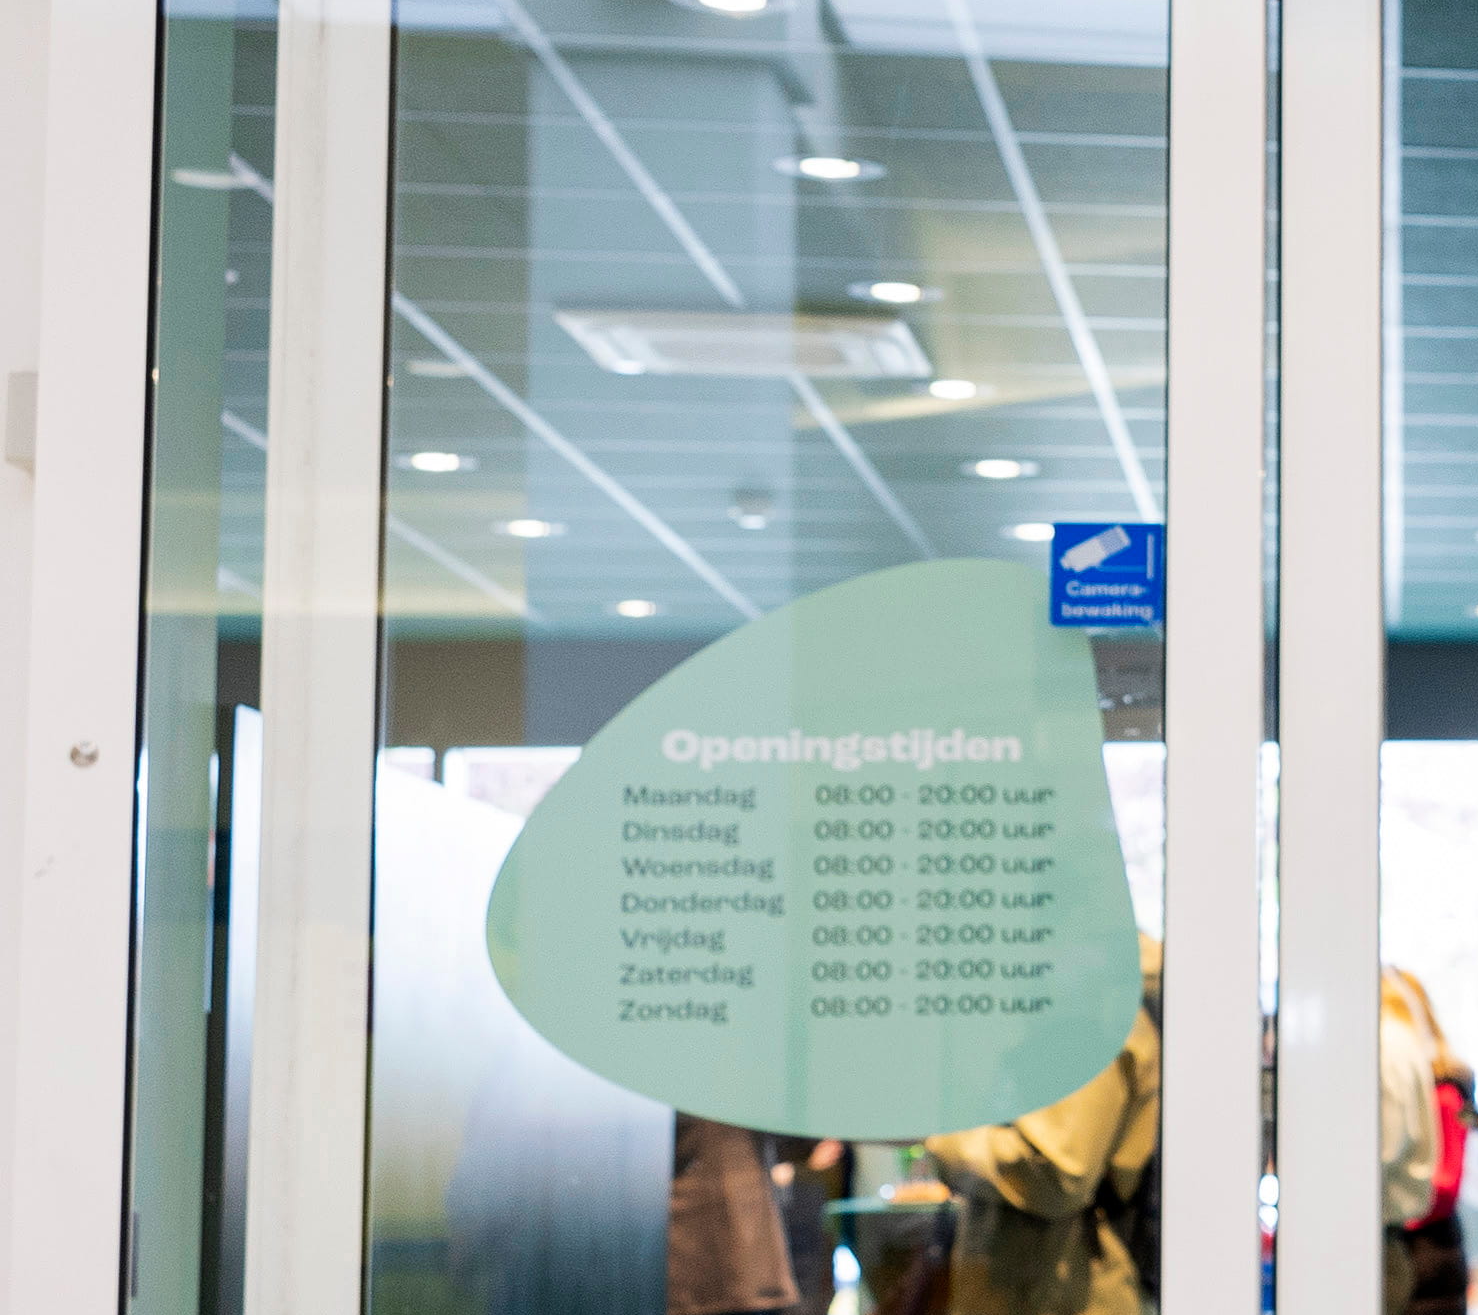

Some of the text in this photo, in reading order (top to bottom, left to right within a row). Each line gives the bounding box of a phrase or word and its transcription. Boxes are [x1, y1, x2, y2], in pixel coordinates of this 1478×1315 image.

[662, 729, 1021, 771] Openingstijden
[623, 785, 756, 811] Maandag
[1002, 788, 1054, 805] uur
[1002, 823, 1054, 840] uur
[621, 856, 775, 882] Woensdag
[1002, 858, 1054, 875] uur
[620, 892, 784, 917] Donderdag
[1002, 892, 1054, 910] uur
[620, 929, 726, 954] Vrijdag
[1002, 927, 1053, 945] uur
[619, 963, 754, 988] Zaterdag
[1002, 962, 1053, 980] uur
[618, 998, 729, 1023] Zondag
[1002, 997, 1053, 1016] uur
